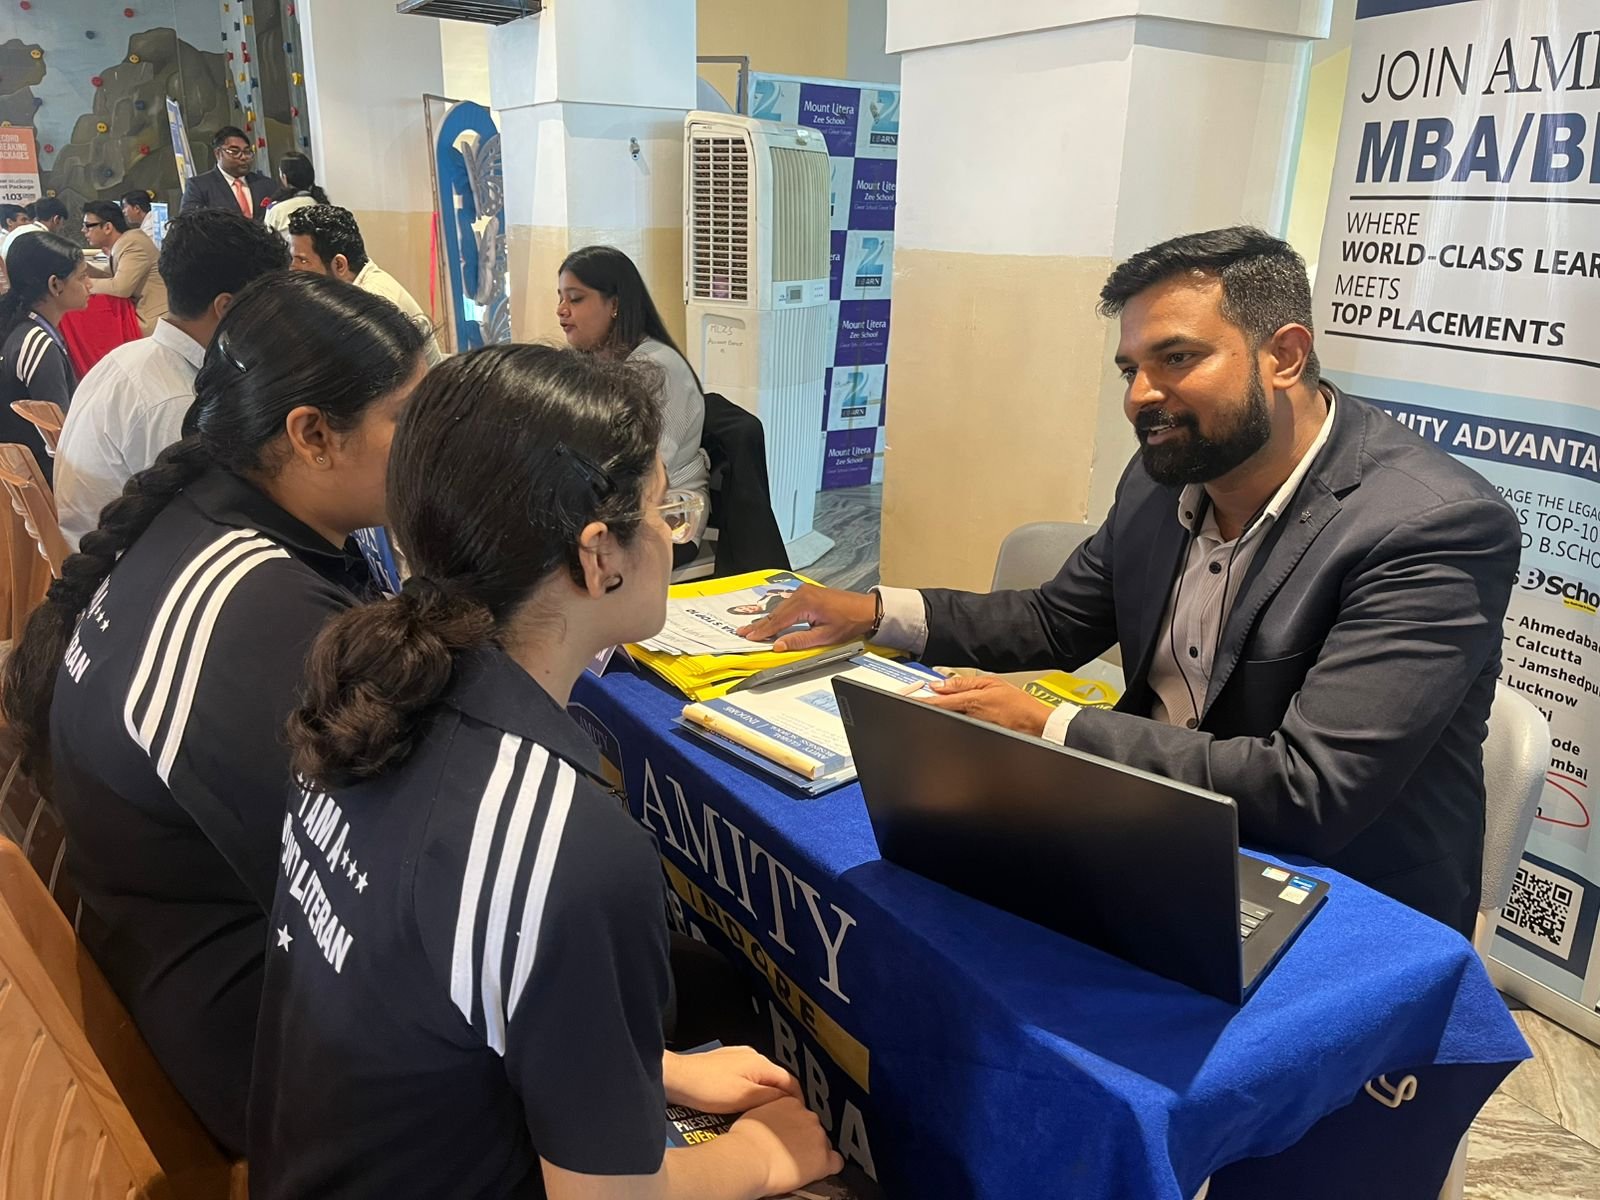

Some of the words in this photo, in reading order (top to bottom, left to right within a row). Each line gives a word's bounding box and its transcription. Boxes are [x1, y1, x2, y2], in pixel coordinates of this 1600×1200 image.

[1361, 43, 1473, 104] JOIN
[804, 100, 830, 114] Mount
[832, 102, 855, 117] Litera
[1355, 112, 1600, 184] MBA/B
[882, 181, 896, 193] Lite
[1347, 211, 1421, 236] WHERE
[1341, 240, 1523, 273] WORLD-CLASS
[1335, 274, 1401, 300] MEETS
[1331, 302, 1373, 325] TOP
[1377, 308, 1566, 347] PLACEMENTS
[1452, 423, 1600, 473] ADVANTA
[1537, 493, 1565, 511] THE
[1568, 500, 1600, 523] LEGA
[1536, 511, 1599, 543] TOP-10
[1515, 635, 1582, 666] Calcutta
[1519, 615, 1600, 653] Ahmedaba
[1507, 674, 1578, 707] Lucknow
[1550, 757, 1588, 781] mbai
[303, 792, 342, 852] AM
[640, 757, 858, 1004] AMITY
[289, 859, 354, 974] LITERAN
[685, 879, 819, 1038] INDORE
